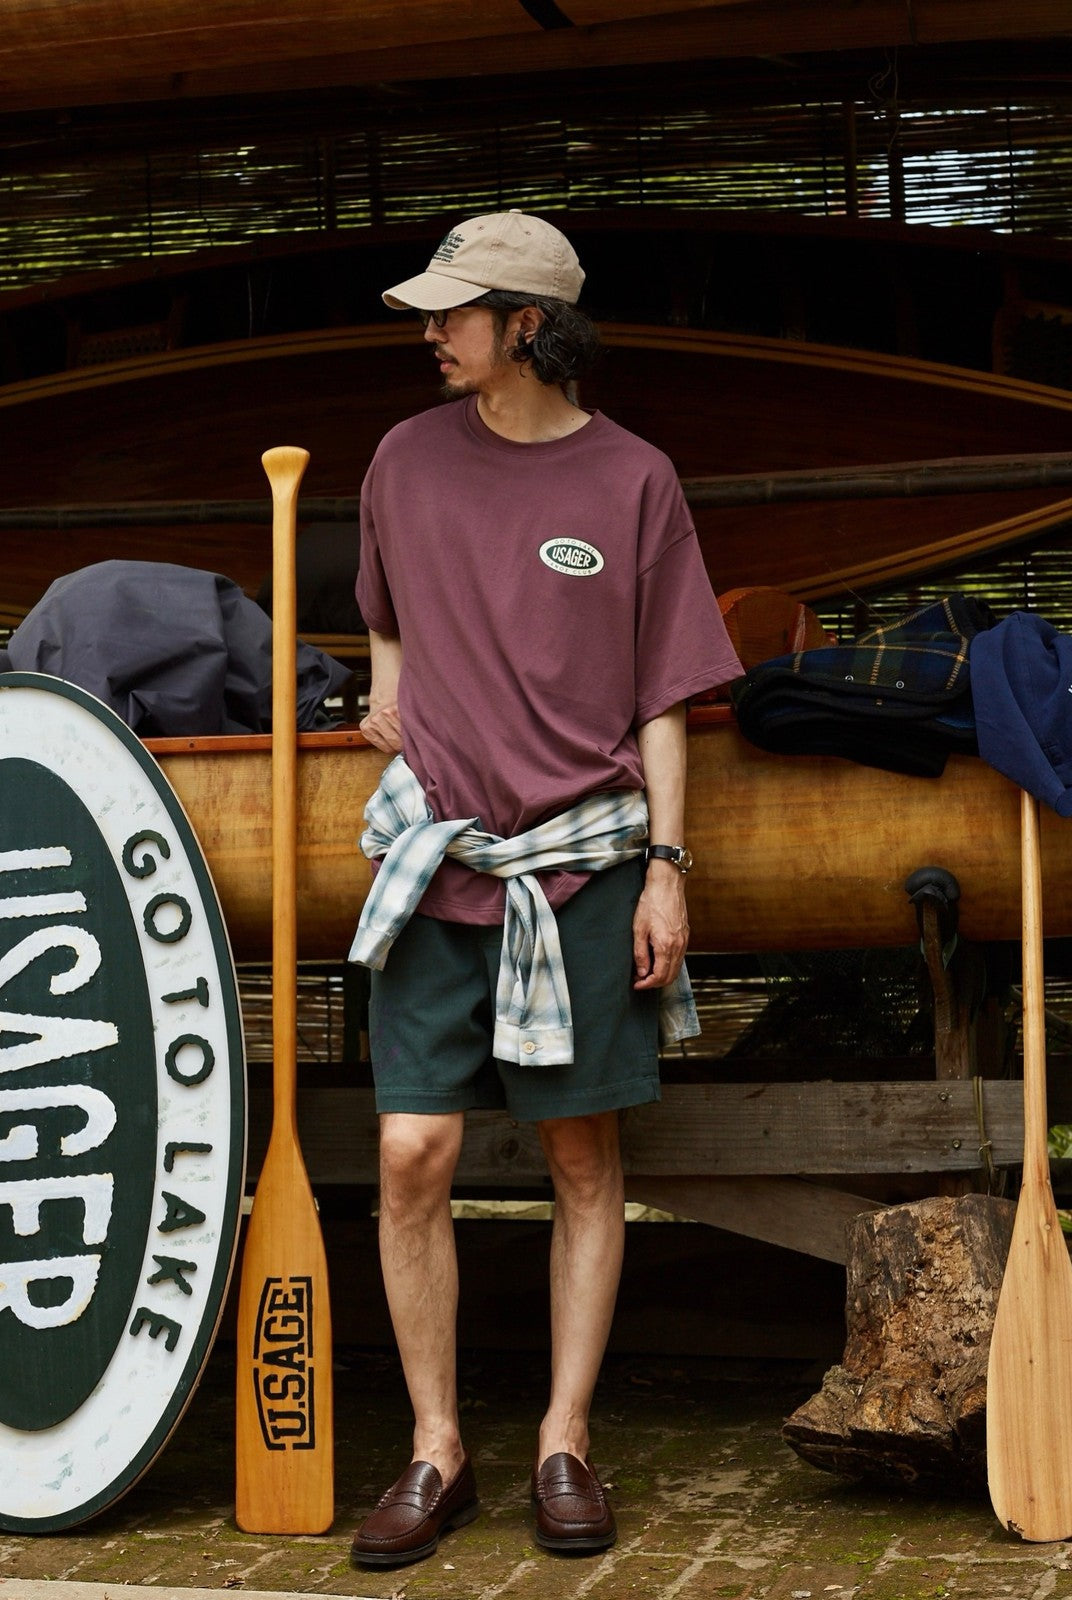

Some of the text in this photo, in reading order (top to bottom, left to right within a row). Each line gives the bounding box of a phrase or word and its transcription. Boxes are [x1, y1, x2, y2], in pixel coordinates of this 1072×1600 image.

[552, 546, 591, 567] USAGER
[129, 1141, 213, 1352] LAKE
[262, 1287, 307, 1440] U.SAGE
